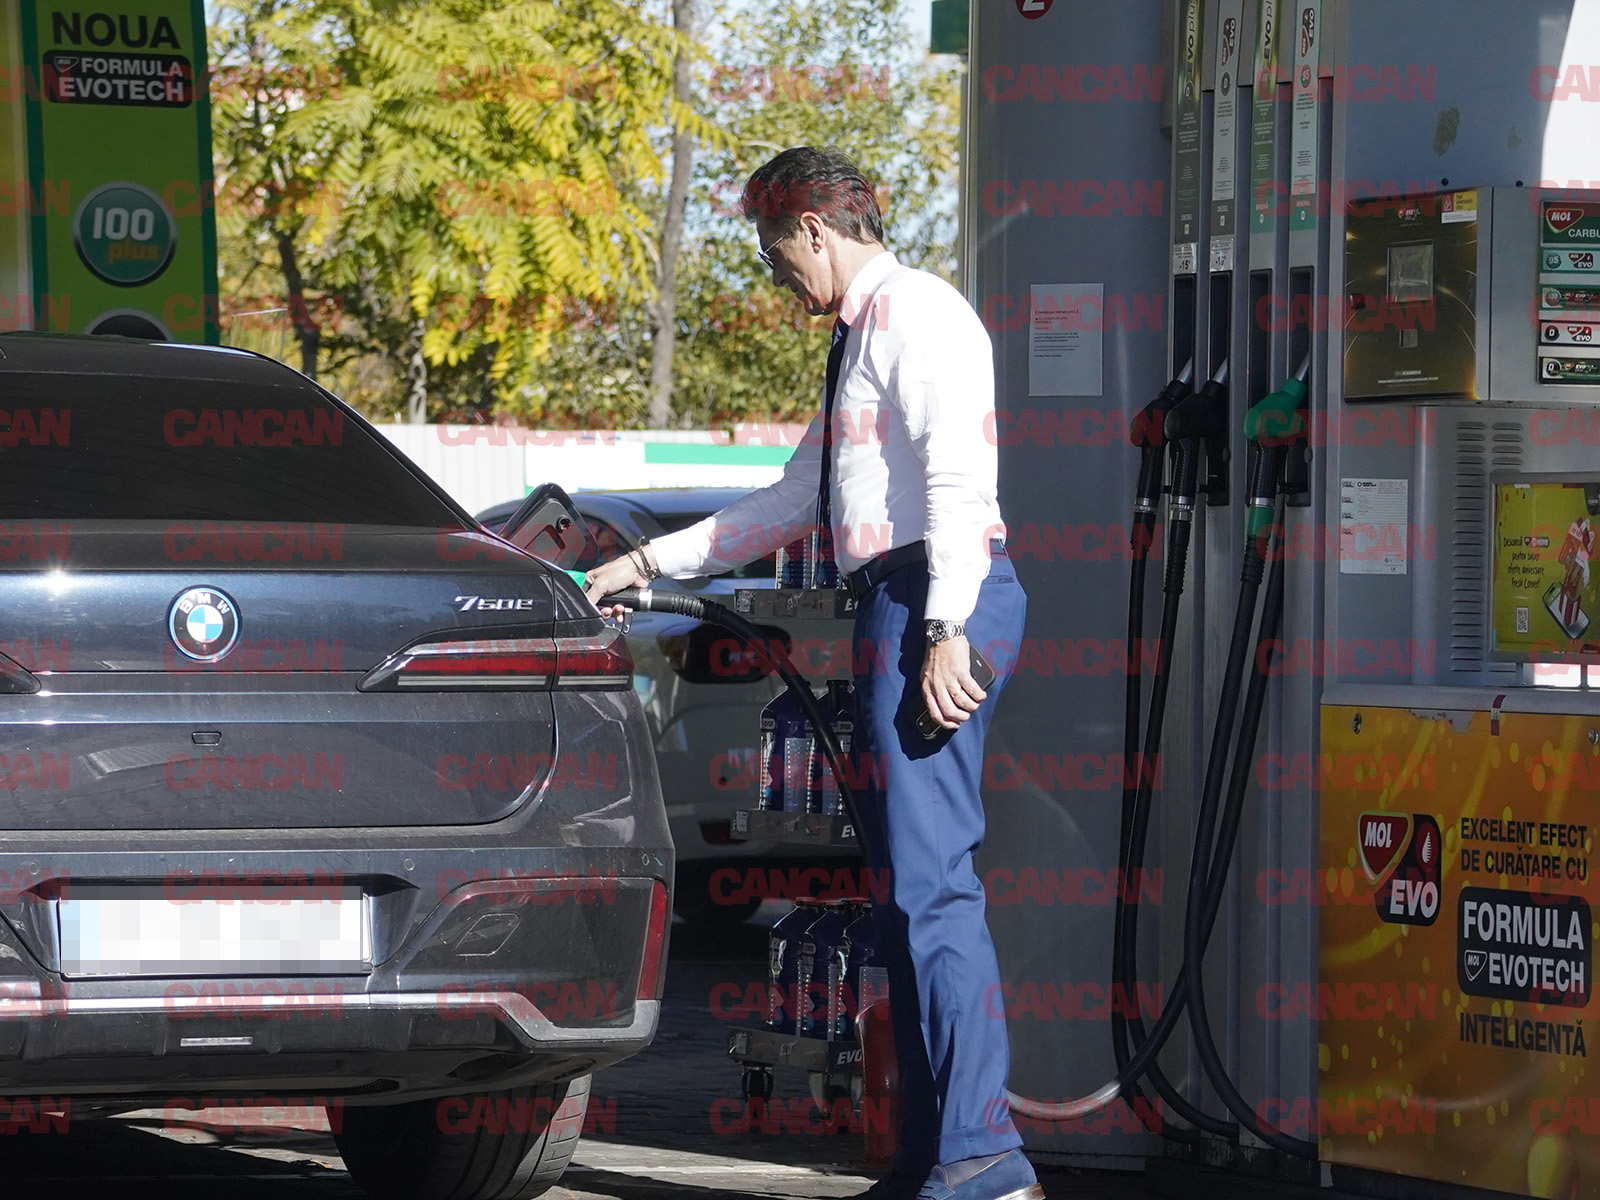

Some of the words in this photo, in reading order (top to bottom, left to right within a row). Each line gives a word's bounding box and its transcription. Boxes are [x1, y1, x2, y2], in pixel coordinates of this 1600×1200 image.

[53, 12, 181, 49] NOUA
[81, 57, 183, 77] FORMULA
[59, 77, 184, 102] EVOTECH
[93, 207, 155, 241] 100
[1551, 211, 1571, 222] MOL
[1549, 256, 1559, 264] 95
[179, 592, 231, 615] BMW
[1365, 821, 1393, 848] MOL
[1461, 817, 1535, 845] EXCELENT
[1539, 823, 1588, 849] EFECT
[1461, 849, 1480, 872] DE
[1565, 857, 1588, 882] CU
[1389, 878, 1438, 919] EVO
[1464, 901, 1585, 950] FORMULA
[1467, 954, 1480, 967] MOL
[1489, 952, 1584, 994] EVOTECH
[1460, 1012, 1587, 1058] INTELIGENTĂ
